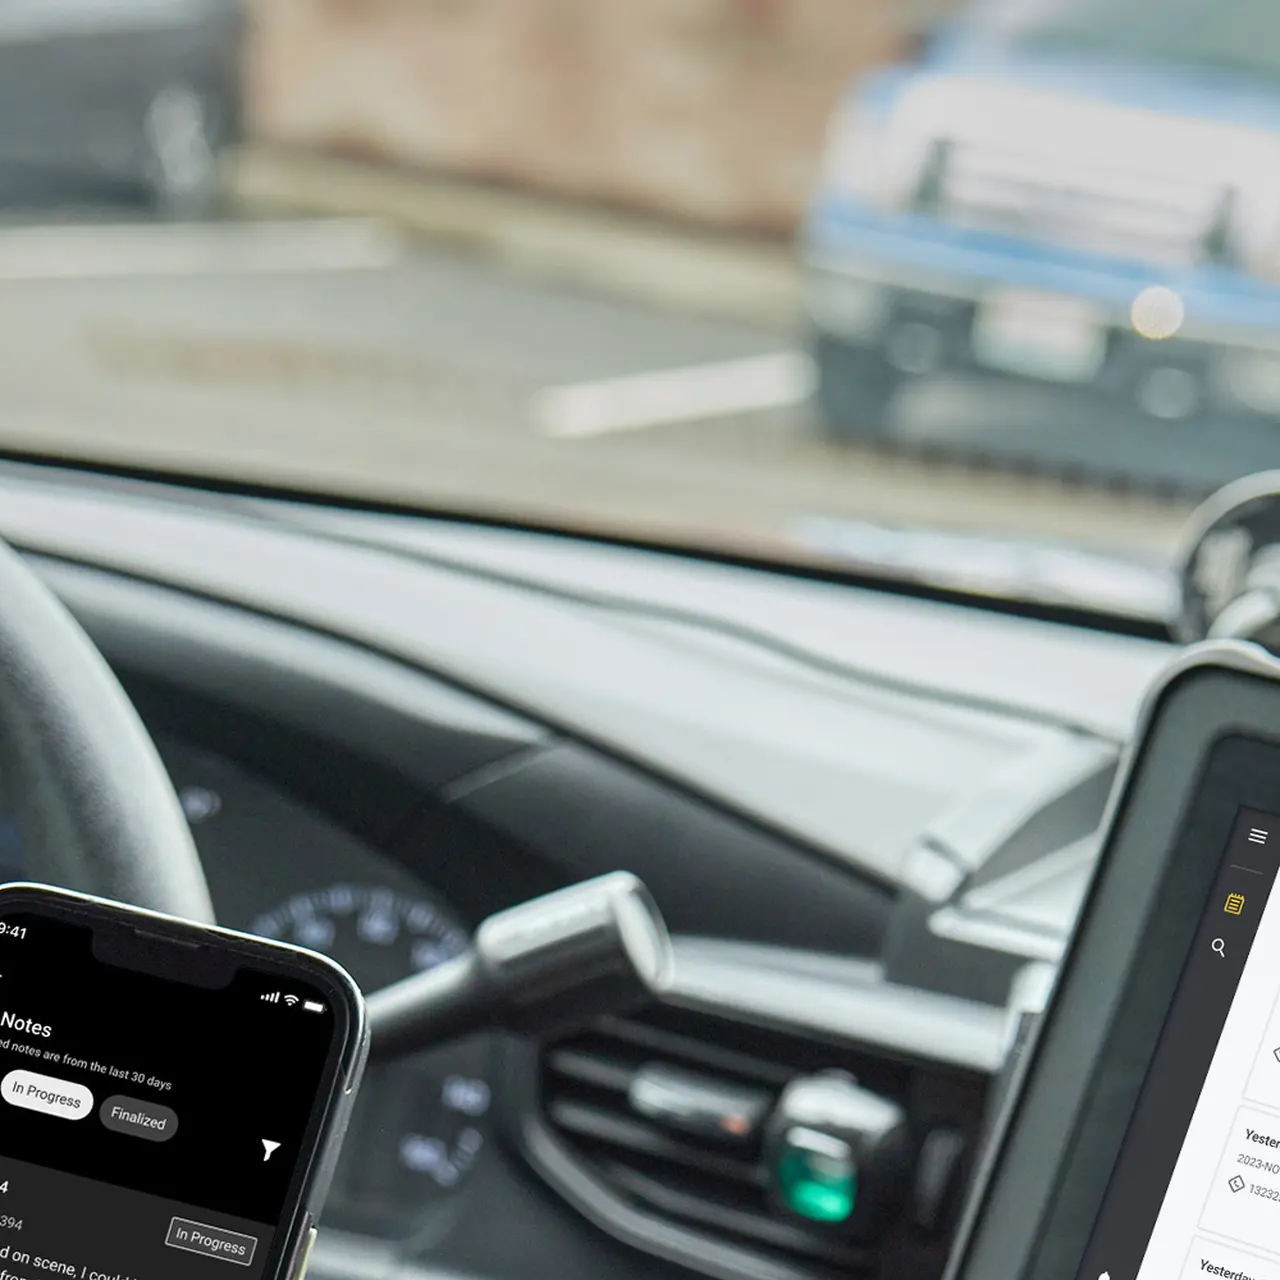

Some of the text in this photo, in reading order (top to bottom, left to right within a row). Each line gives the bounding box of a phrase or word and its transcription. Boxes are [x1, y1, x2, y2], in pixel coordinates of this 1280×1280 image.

[0, 1010, 52, 1038] Notes
[10, 1043, 42, 1058] notes
[42, 1051, 61, 1062] are
[62, 1053, 88, 1069] from
[90, 1061, 108, 1074] the
[108, 1065, 130, 1080] last
[130, 1071, 146, 1084] 30
[146, 1076, 172, 1091] days
[12, 1081, 82, 1109] In Progress
[110, 1106, 167, 1131] Finalized
[175, 1227, 246, 1256] In Progress
[11, 1251, 30, 1265] on
[32, 1256, 77, 1279] scene,
[80, 1266, 87, 1279] I
